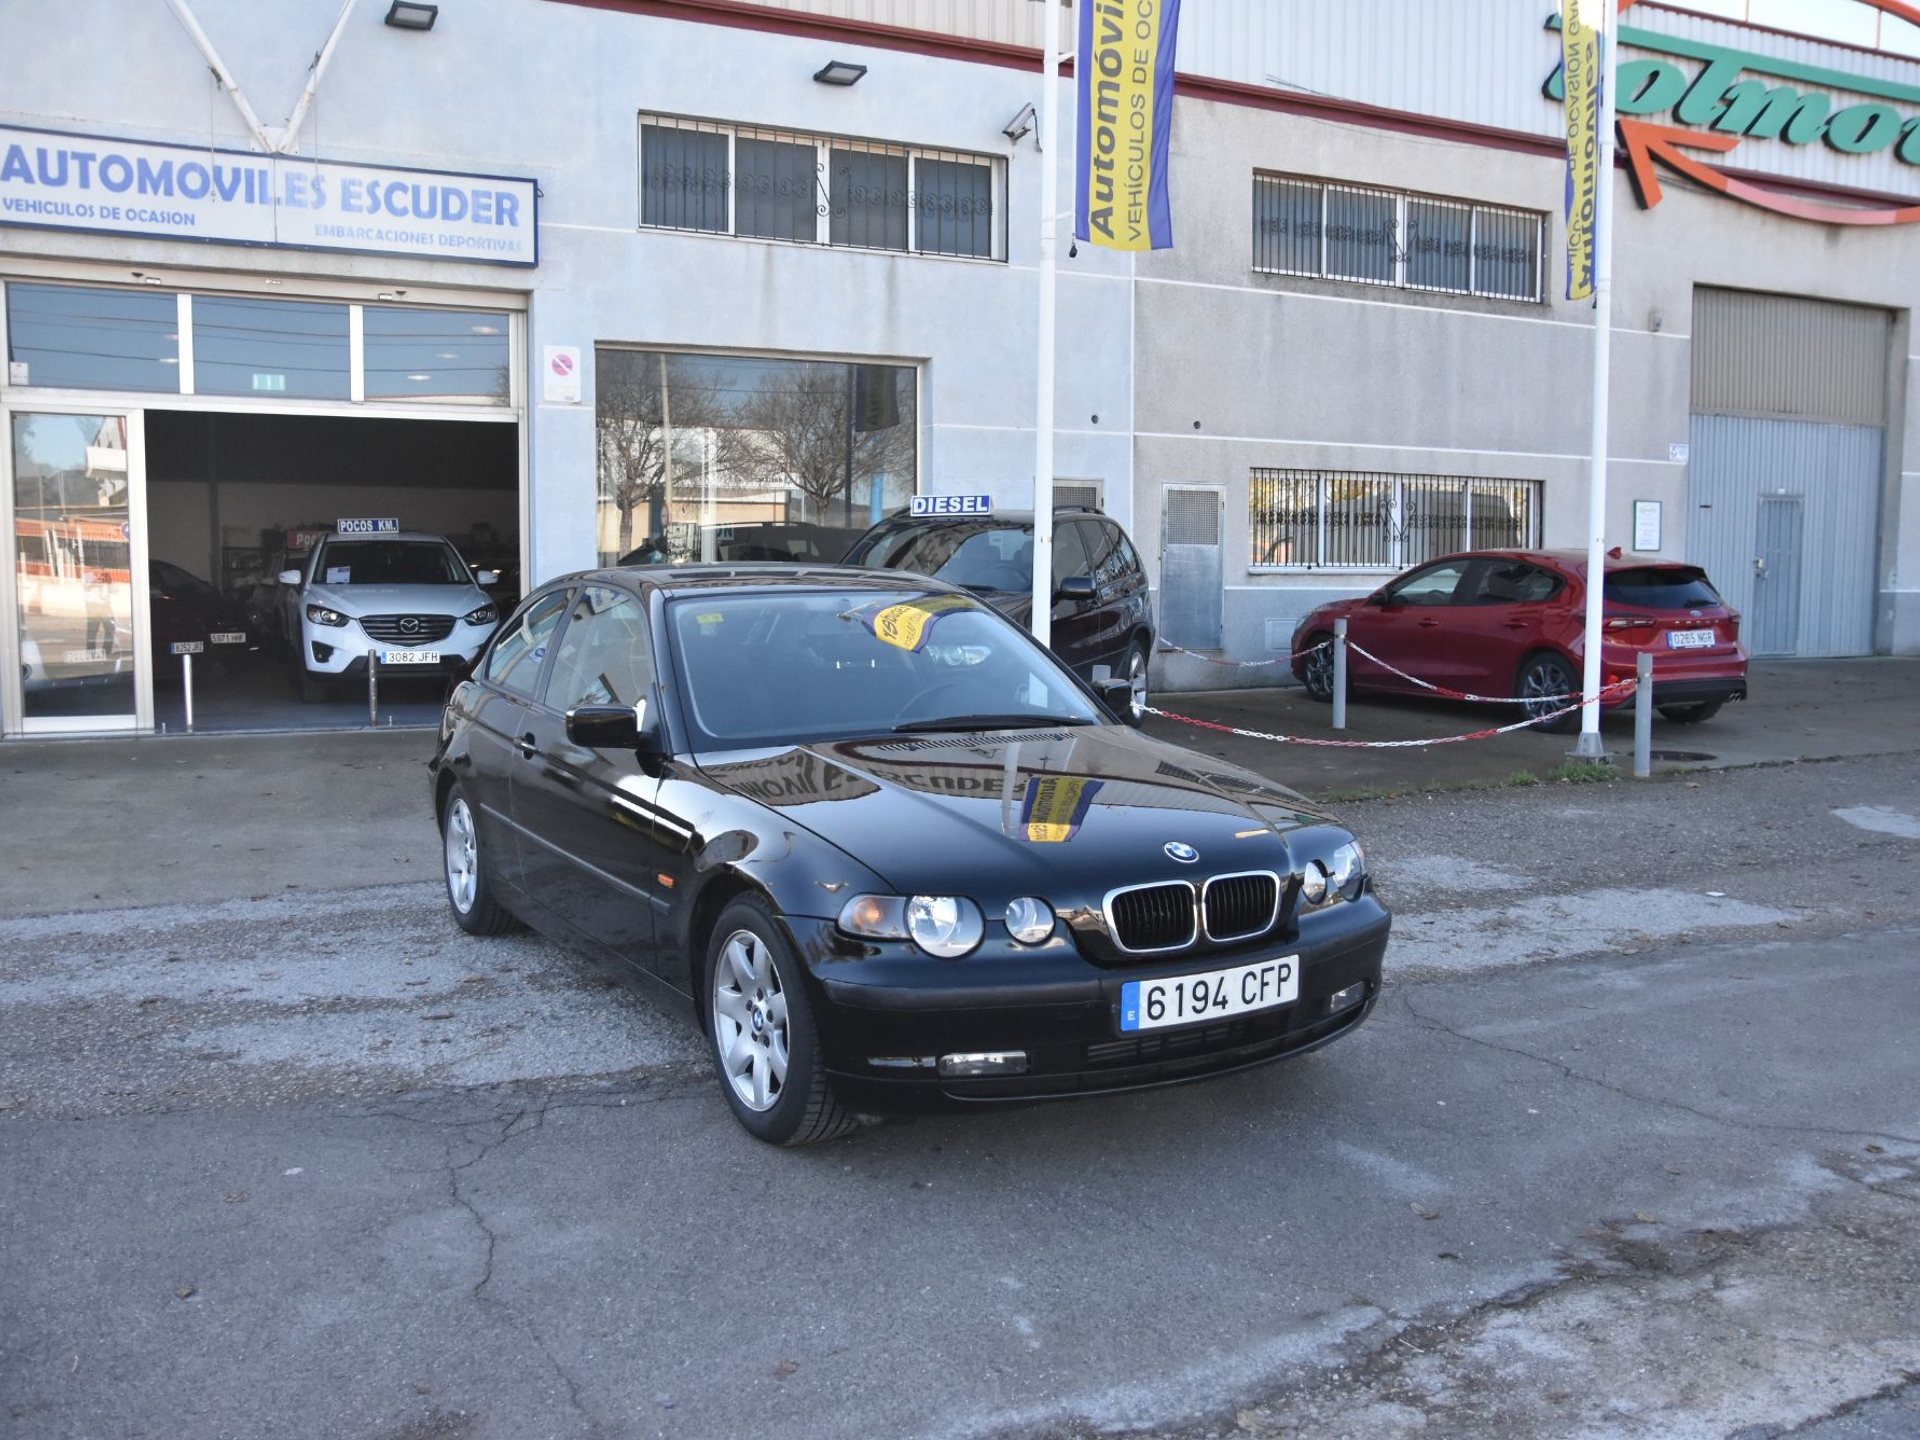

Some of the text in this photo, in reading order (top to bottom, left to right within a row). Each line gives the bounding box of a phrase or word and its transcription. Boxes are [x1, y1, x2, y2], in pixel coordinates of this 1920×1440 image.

[1131, 47, 1149, 85] DE
[1090, 0, 1124, 240] Automóvi
[1123, 93, 1146, 242] VEHÍCULOS
[0, 143, 520, 227] AUTOMOVILES ESCUDER
[2, 197, 196, 226] VEHICULOS DE OCASION
[314, 223, 522, 252] EMBARCACIONES DEPORTIVAS
[913, 496, 988, 513] DIESEL
[340, 520, 396, 532] POCOS KM.
[1674, 633, 1696, 645] 0265
[389, 652, 438, 663] 3082 JFH
[1147, 976, 1229, 1021] 6194
[1241, 963, 1292, 1005] CFP
